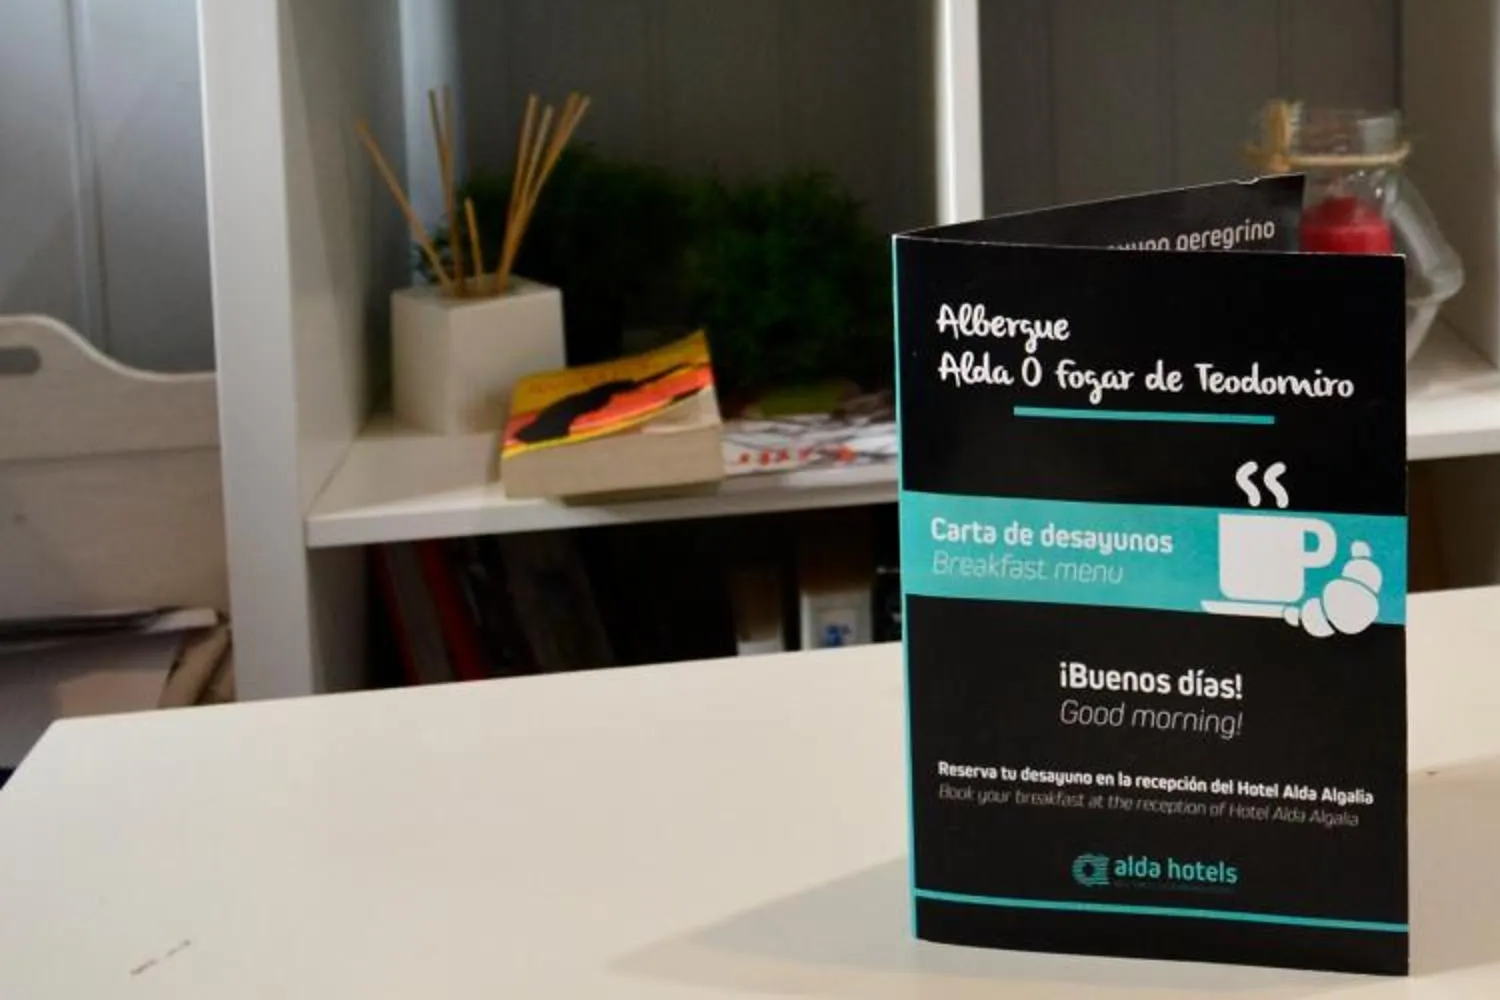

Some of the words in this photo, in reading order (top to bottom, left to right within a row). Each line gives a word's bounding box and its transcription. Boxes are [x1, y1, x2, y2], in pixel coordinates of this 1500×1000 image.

[936, 303, 1070, 352] Albergue
[938, 352, 1013, 387] Alda
[1021, 356, 1042, 387] O
[1144, 359, 1183, 393] de
[1194, 362, 1355, 398] Teodomiro
[931, 518, 997, 545] Carta
[1003, 520, 1033, 546] de
[1041, 523, 1173, 554] desayunos
[932, 551, 1046, 580] Breakfast
[1054, 562, 1124, 584] menu
[1059, 661, 1171, 694] ¡Buenos
[1178, 667, 1244, 699] días!
[1060, 699, 1125, 728] Good
[1131, 708, 1244, 741] morning!
[938, 761, 997, 777] Reserva
[1001, 767, 1017, 780] tu
[1021, 767, 1093, 785] desayuno
[1096, 774, 1115, 786] en
[1118, 771, 1132, 787] la
[1135, 776, 1207, 792] recepción
[1211, 778, 1234, 794] del
[1238, 780, 1279, 798] Hotel
[1283, 783, 1317, 801] Alda
[1321, 787, 1374, 806] Algalia
[939, 785, 972, 799] Book
[977, 790, 1010, 804] your
[1015, 789, 1083, 806] breakfast
[1089, 795, 1103, 807] at
[1108, 796, 1132, 809] the
[1136, 799, 1207, 815] reception
[1209, 800, 1226, 816] of
[1229, 803, 1269, 821] Hotel
[1272, 805, 1306, 823] Alda
[1310, 808, 1359, 828] Algalia
[1115, 856, 1161, 877] alda
[1168, 858, 1237, 883] hotels
